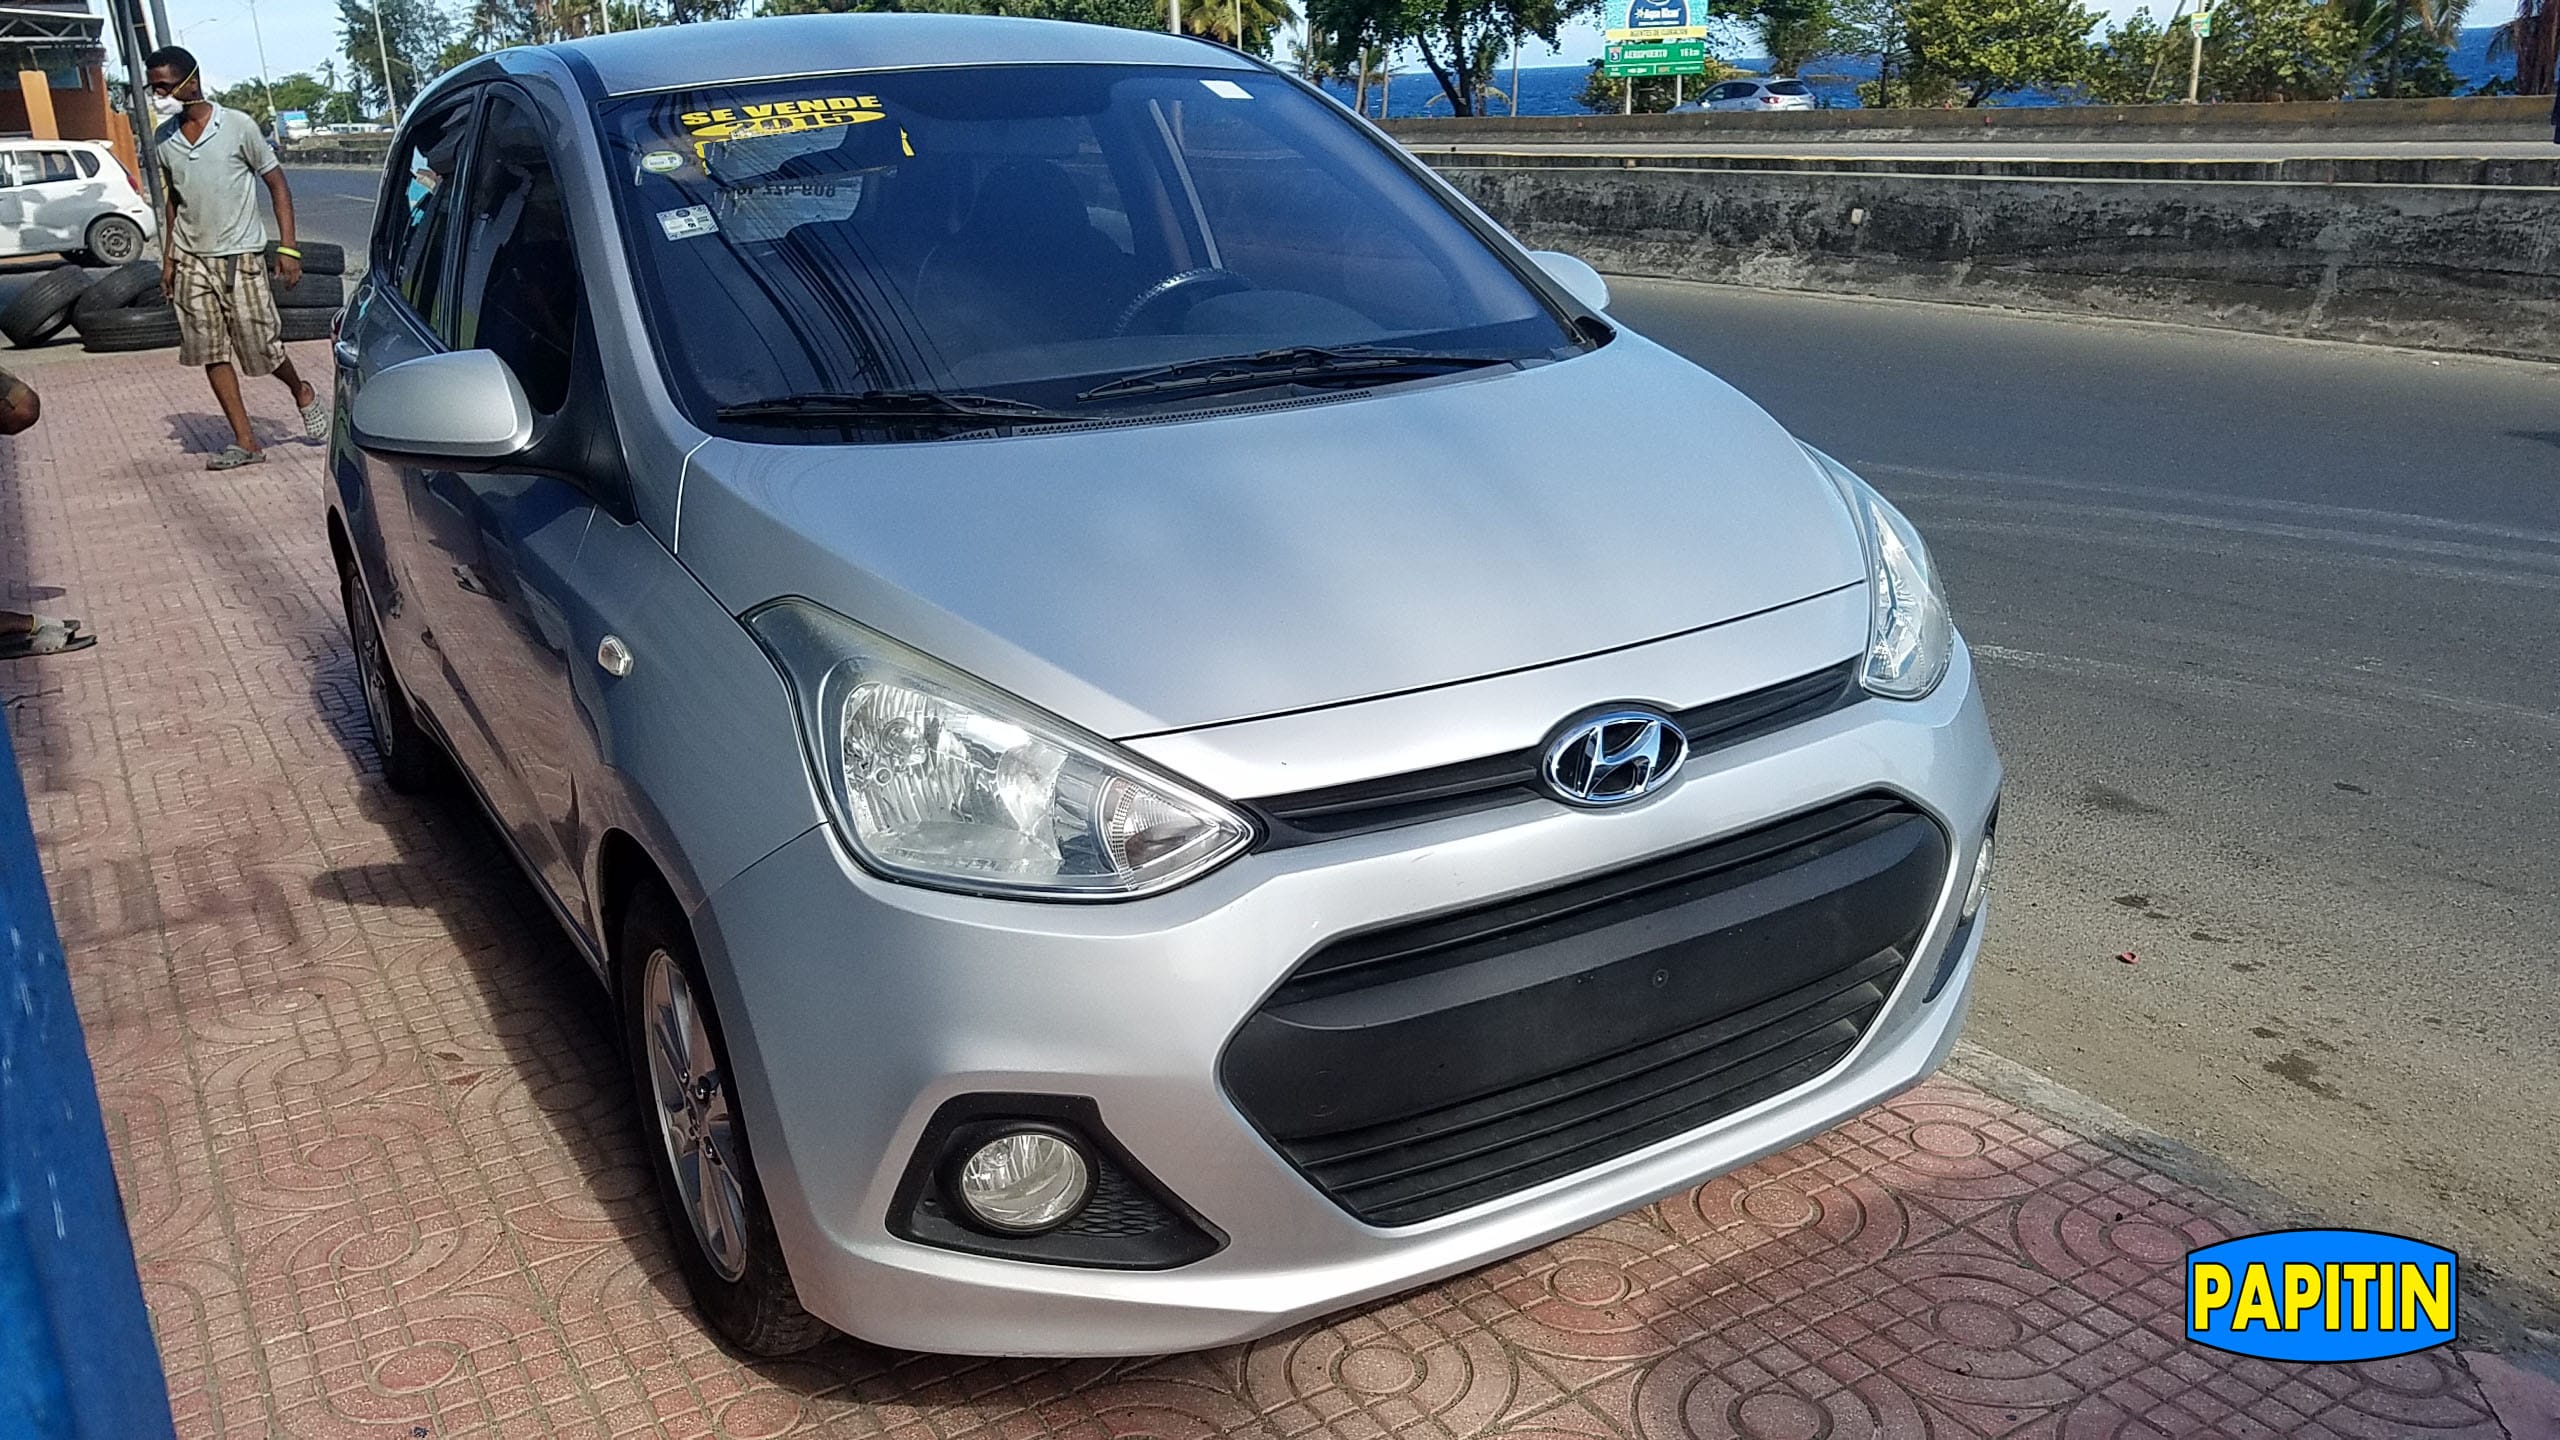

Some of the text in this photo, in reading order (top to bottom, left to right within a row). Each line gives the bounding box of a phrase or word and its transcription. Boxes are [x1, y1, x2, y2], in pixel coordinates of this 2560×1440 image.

[681, 96, 882, 126] SE VENDE
[724, 111, 855, 135] 2015
